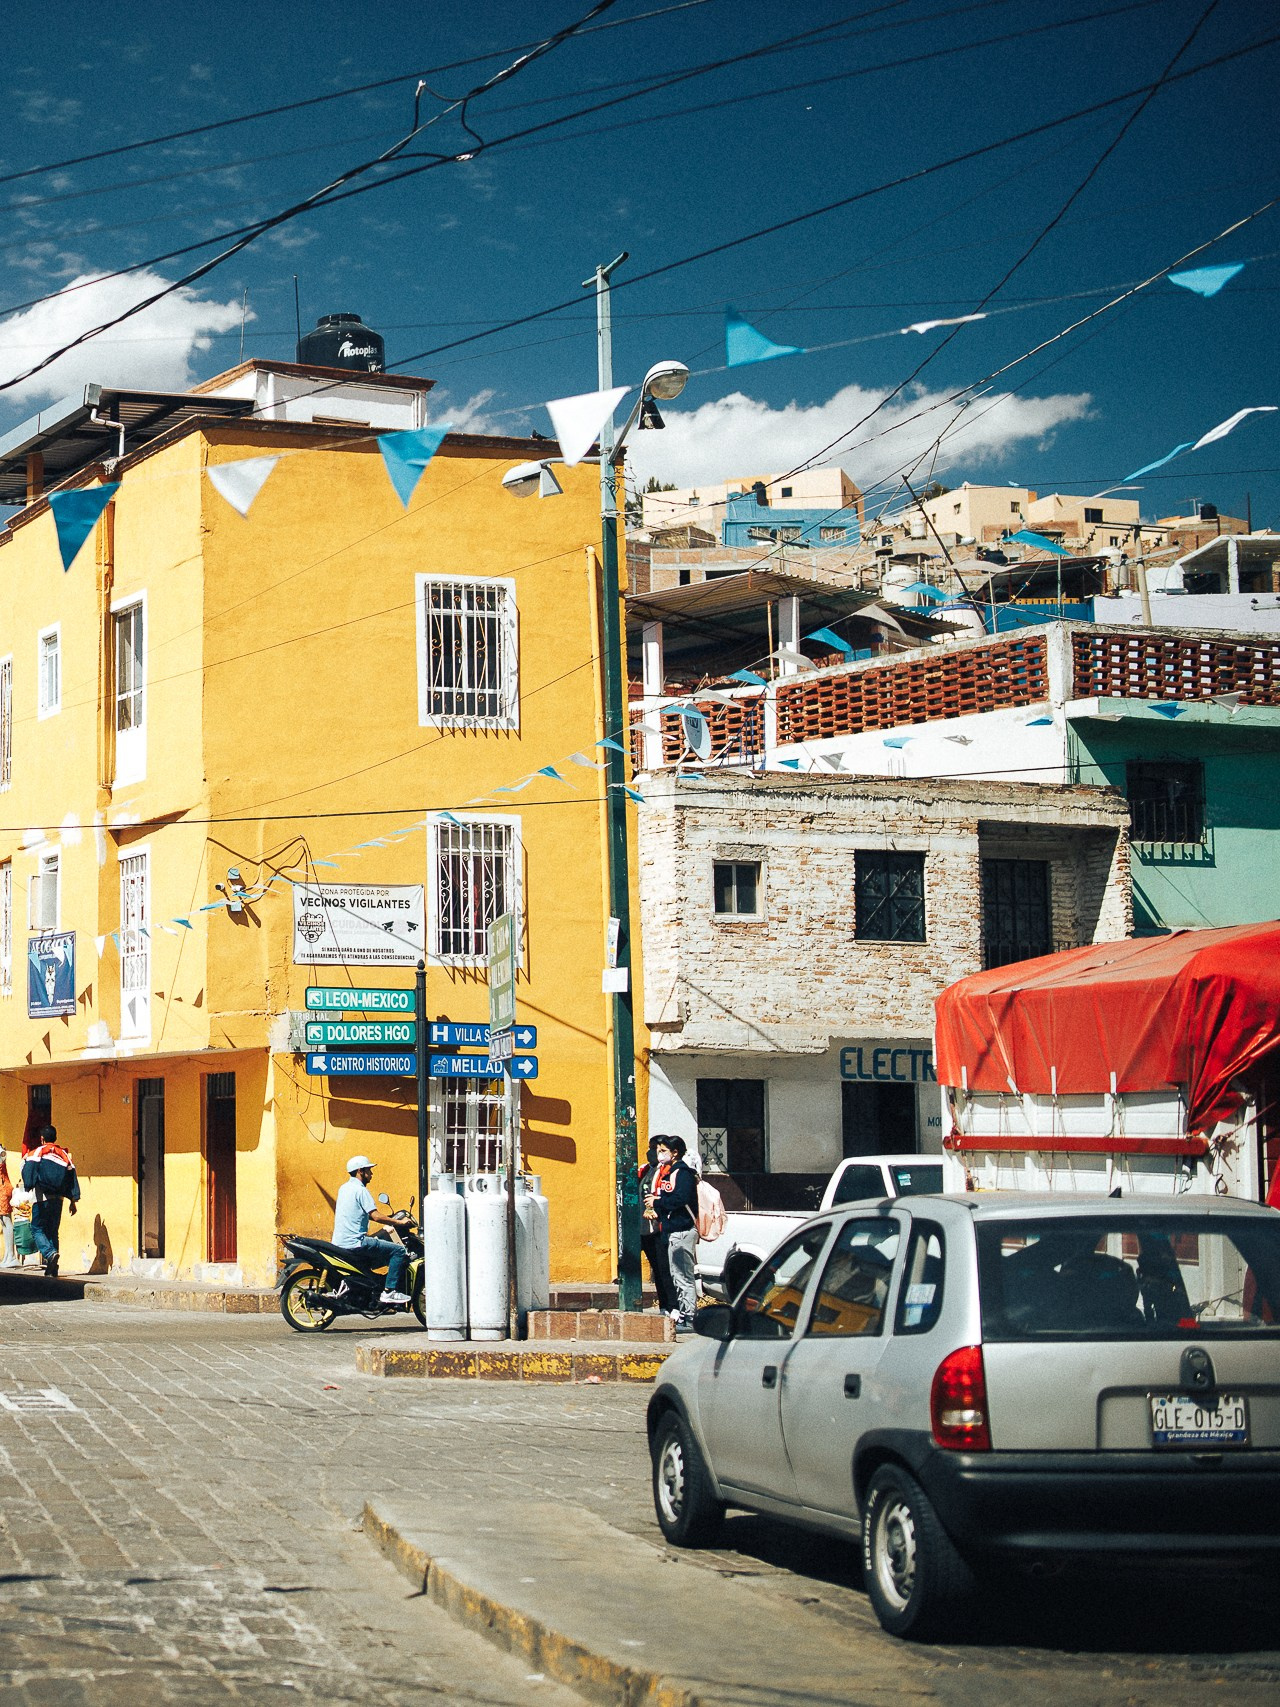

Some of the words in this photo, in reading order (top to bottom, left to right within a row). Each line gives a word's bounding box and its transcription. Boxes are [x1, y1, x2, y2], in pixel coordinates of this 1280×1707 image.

[343, 345, 378, 358] Rotoplas
[300, 898, 346, 907] VECINOS
[349, 899, 411, 909] VIGILANTES
[325, 991, 408, 1008] LEON-MEXICO
[327, 1025, 382, 1041] DOLORES
[384, 1026, 410, 1041] HGO
[455, 1027, 482, 1042] VILLA
[330, 1057, 365, 1071] CENTRO
[366, 1057, 411, 1072] HISTORICO
[1154, 1407, 1244, 1430] GLE-015-D
